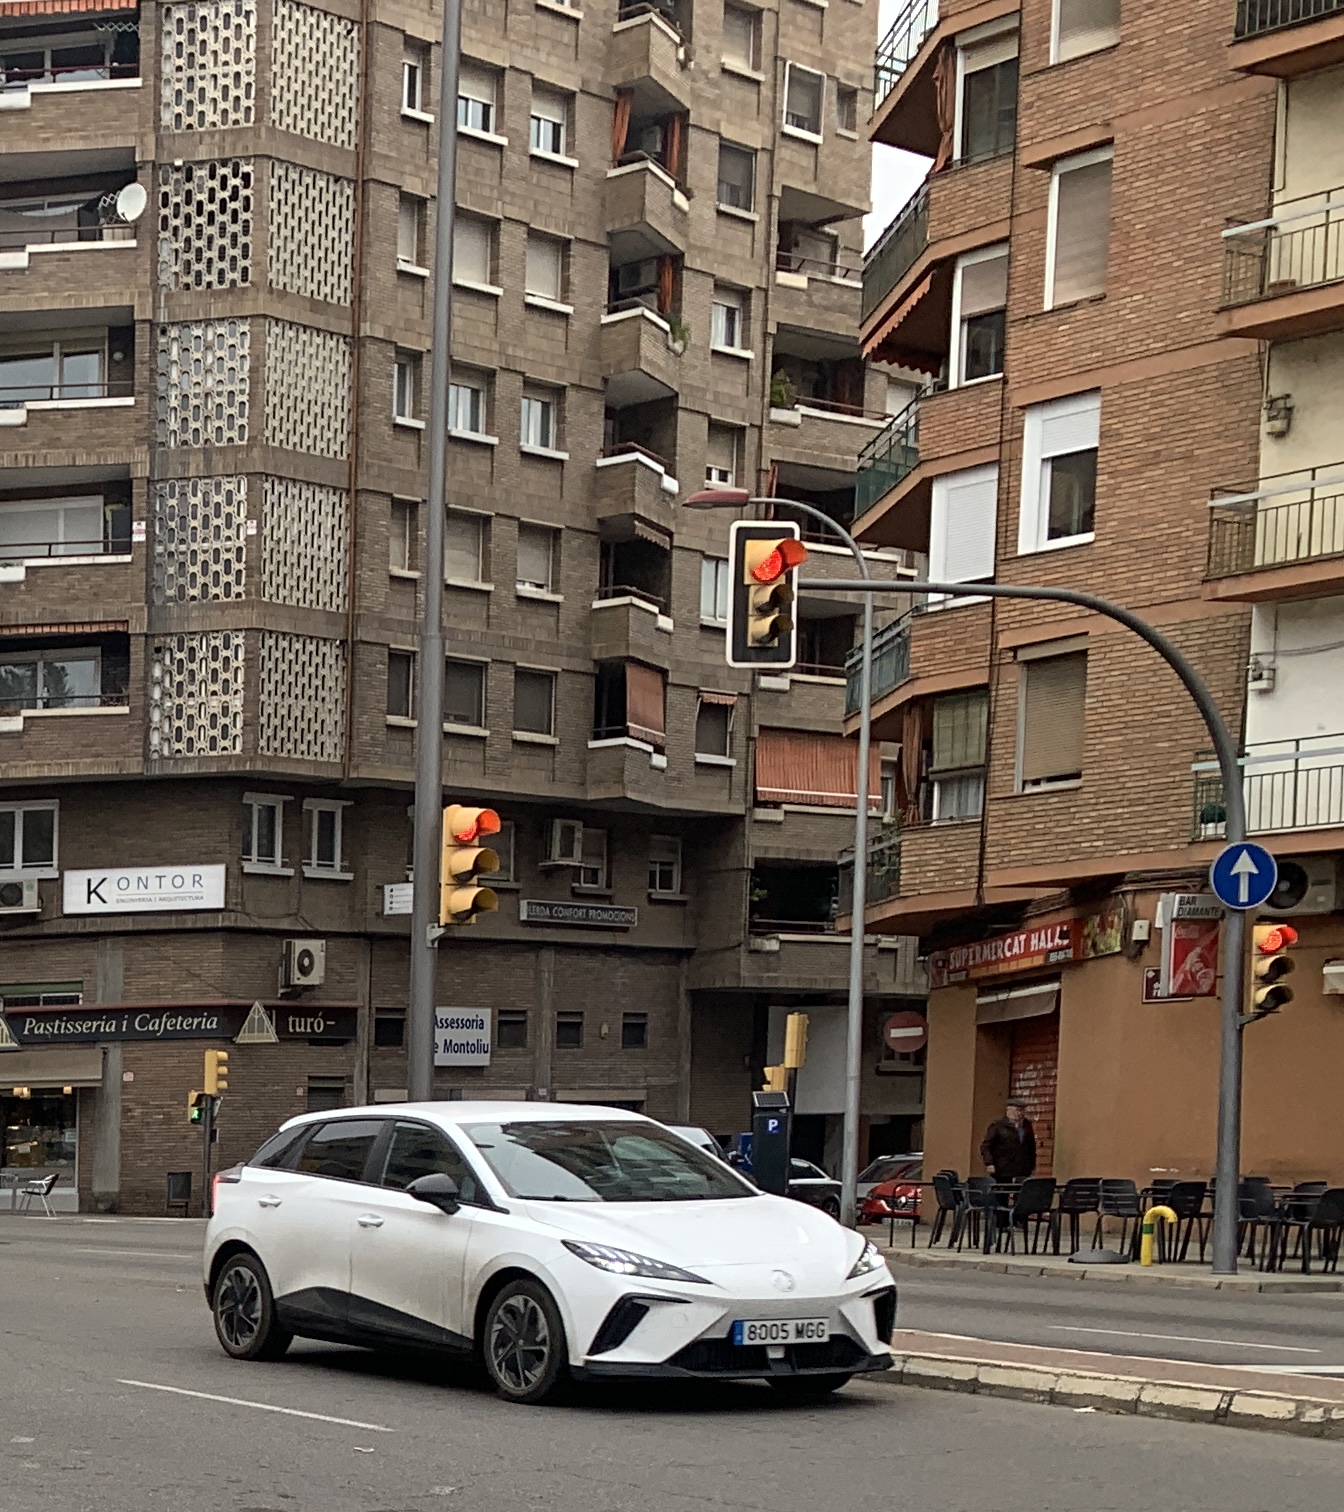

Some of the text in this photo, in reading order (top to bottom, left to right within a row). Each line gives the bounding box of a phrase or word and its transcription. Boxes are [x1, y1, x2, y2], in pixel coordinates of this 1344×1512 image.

[86, 874, 204, 905] KONTOR
[1179, 896, 1197, 906] BAR
[552, 906, 587, 919] CONFORT
[1178, 906, 1220, 917] DIAMANTE
[949, 934, 1026, 970] SUPERMERCAT
[23, 1011, 218, 1037] Pastisseria i Cafeteria
[288, 1011, 324, 1033] turó
[443, 1038, 489, 1055] Montoliu
[768, 1119, 778, 1131] P
[747, 1321, 826, 1341] 8005 MGG
